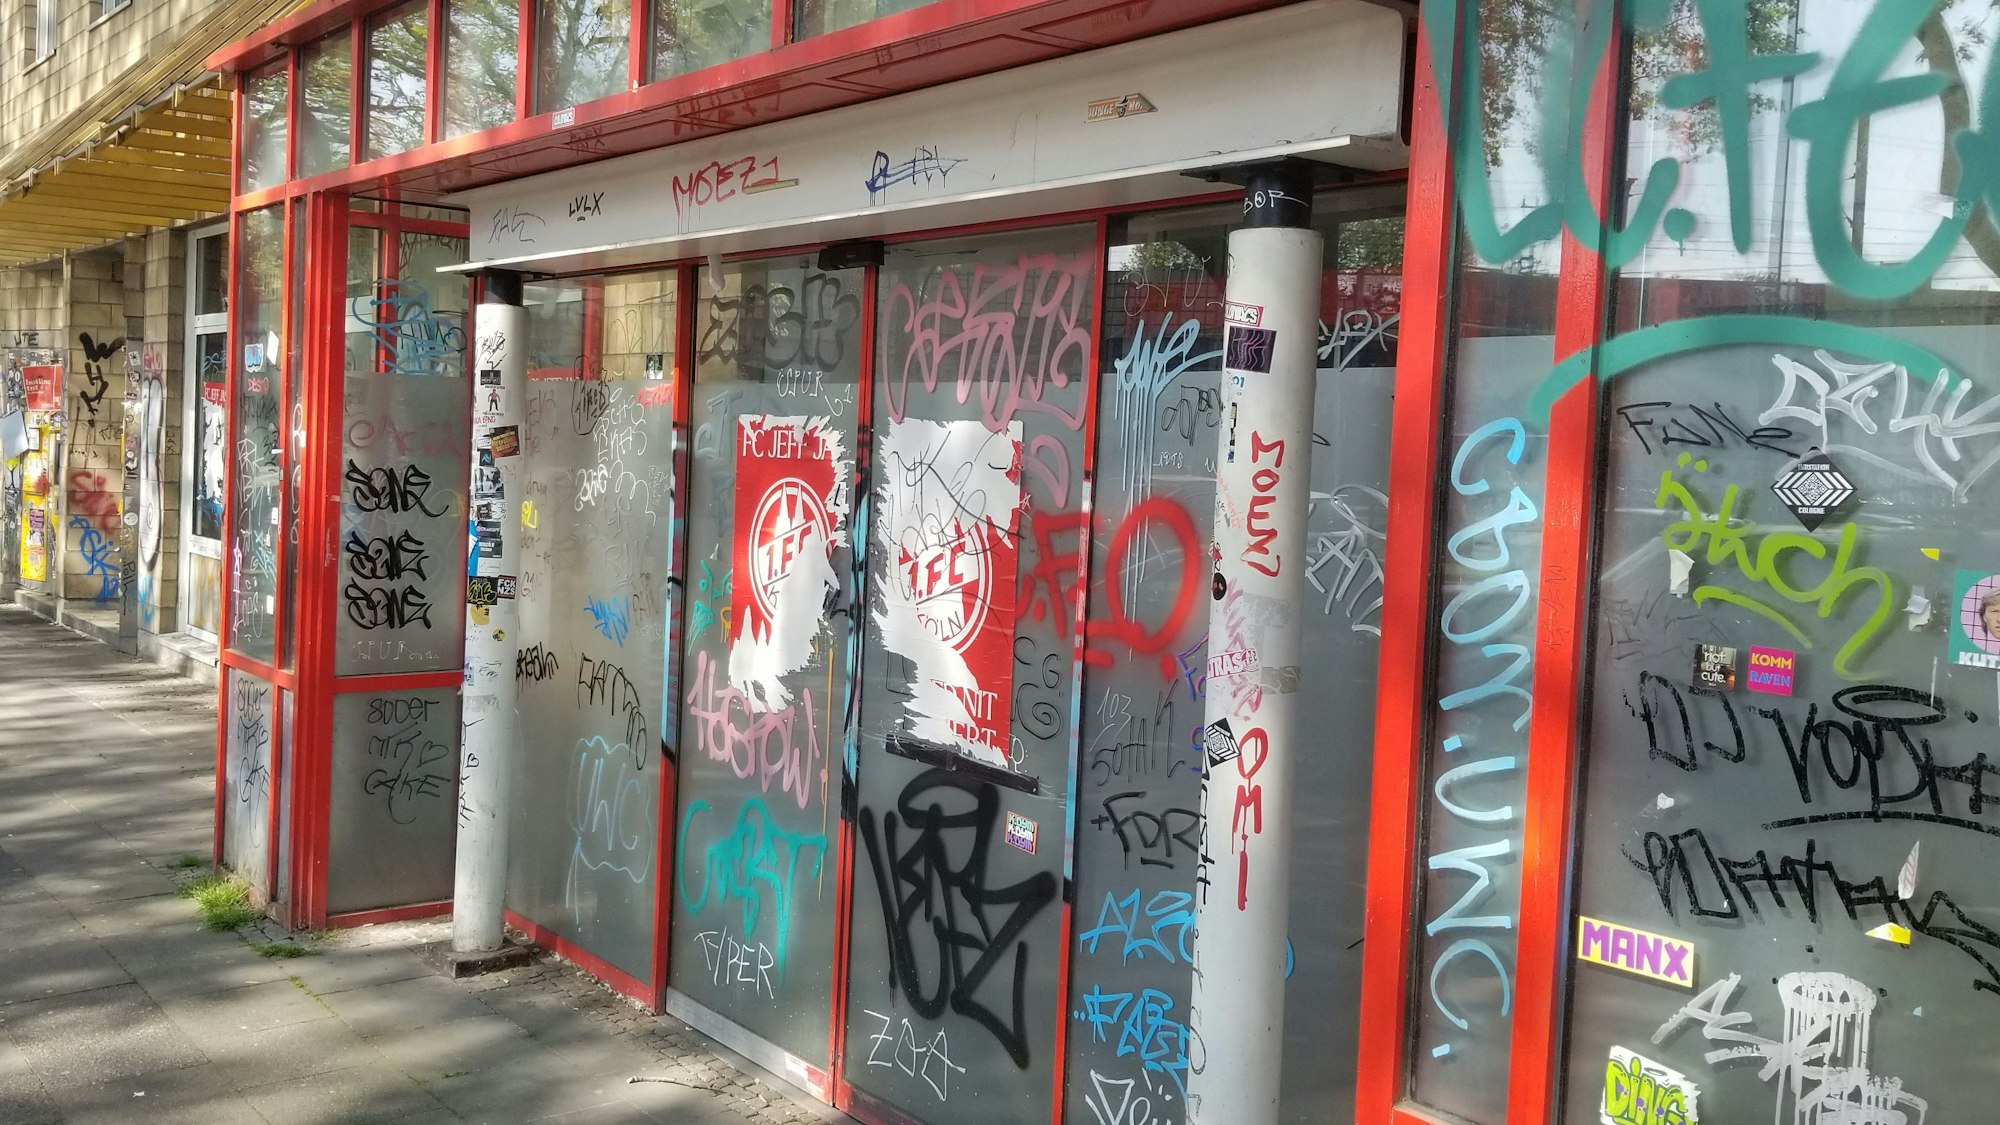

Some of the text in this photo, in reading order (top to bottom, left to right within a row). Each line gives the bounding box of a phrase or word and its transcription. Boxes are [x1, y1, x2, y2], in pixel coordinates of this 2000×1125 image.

[1798, 507, 1826, 515] COLOGNE
[497, 578, 516, 588] FCK
[497, 586, 515, 596] NZS
[1704, 651, 1726, 664] riot
[1751, 652, 1793, 670] KOMM
[1706, 661, 1721, 672] but
[1749, 670, 1791, 687] RAVEN
[1581, 920, 1689, 982] MANX
